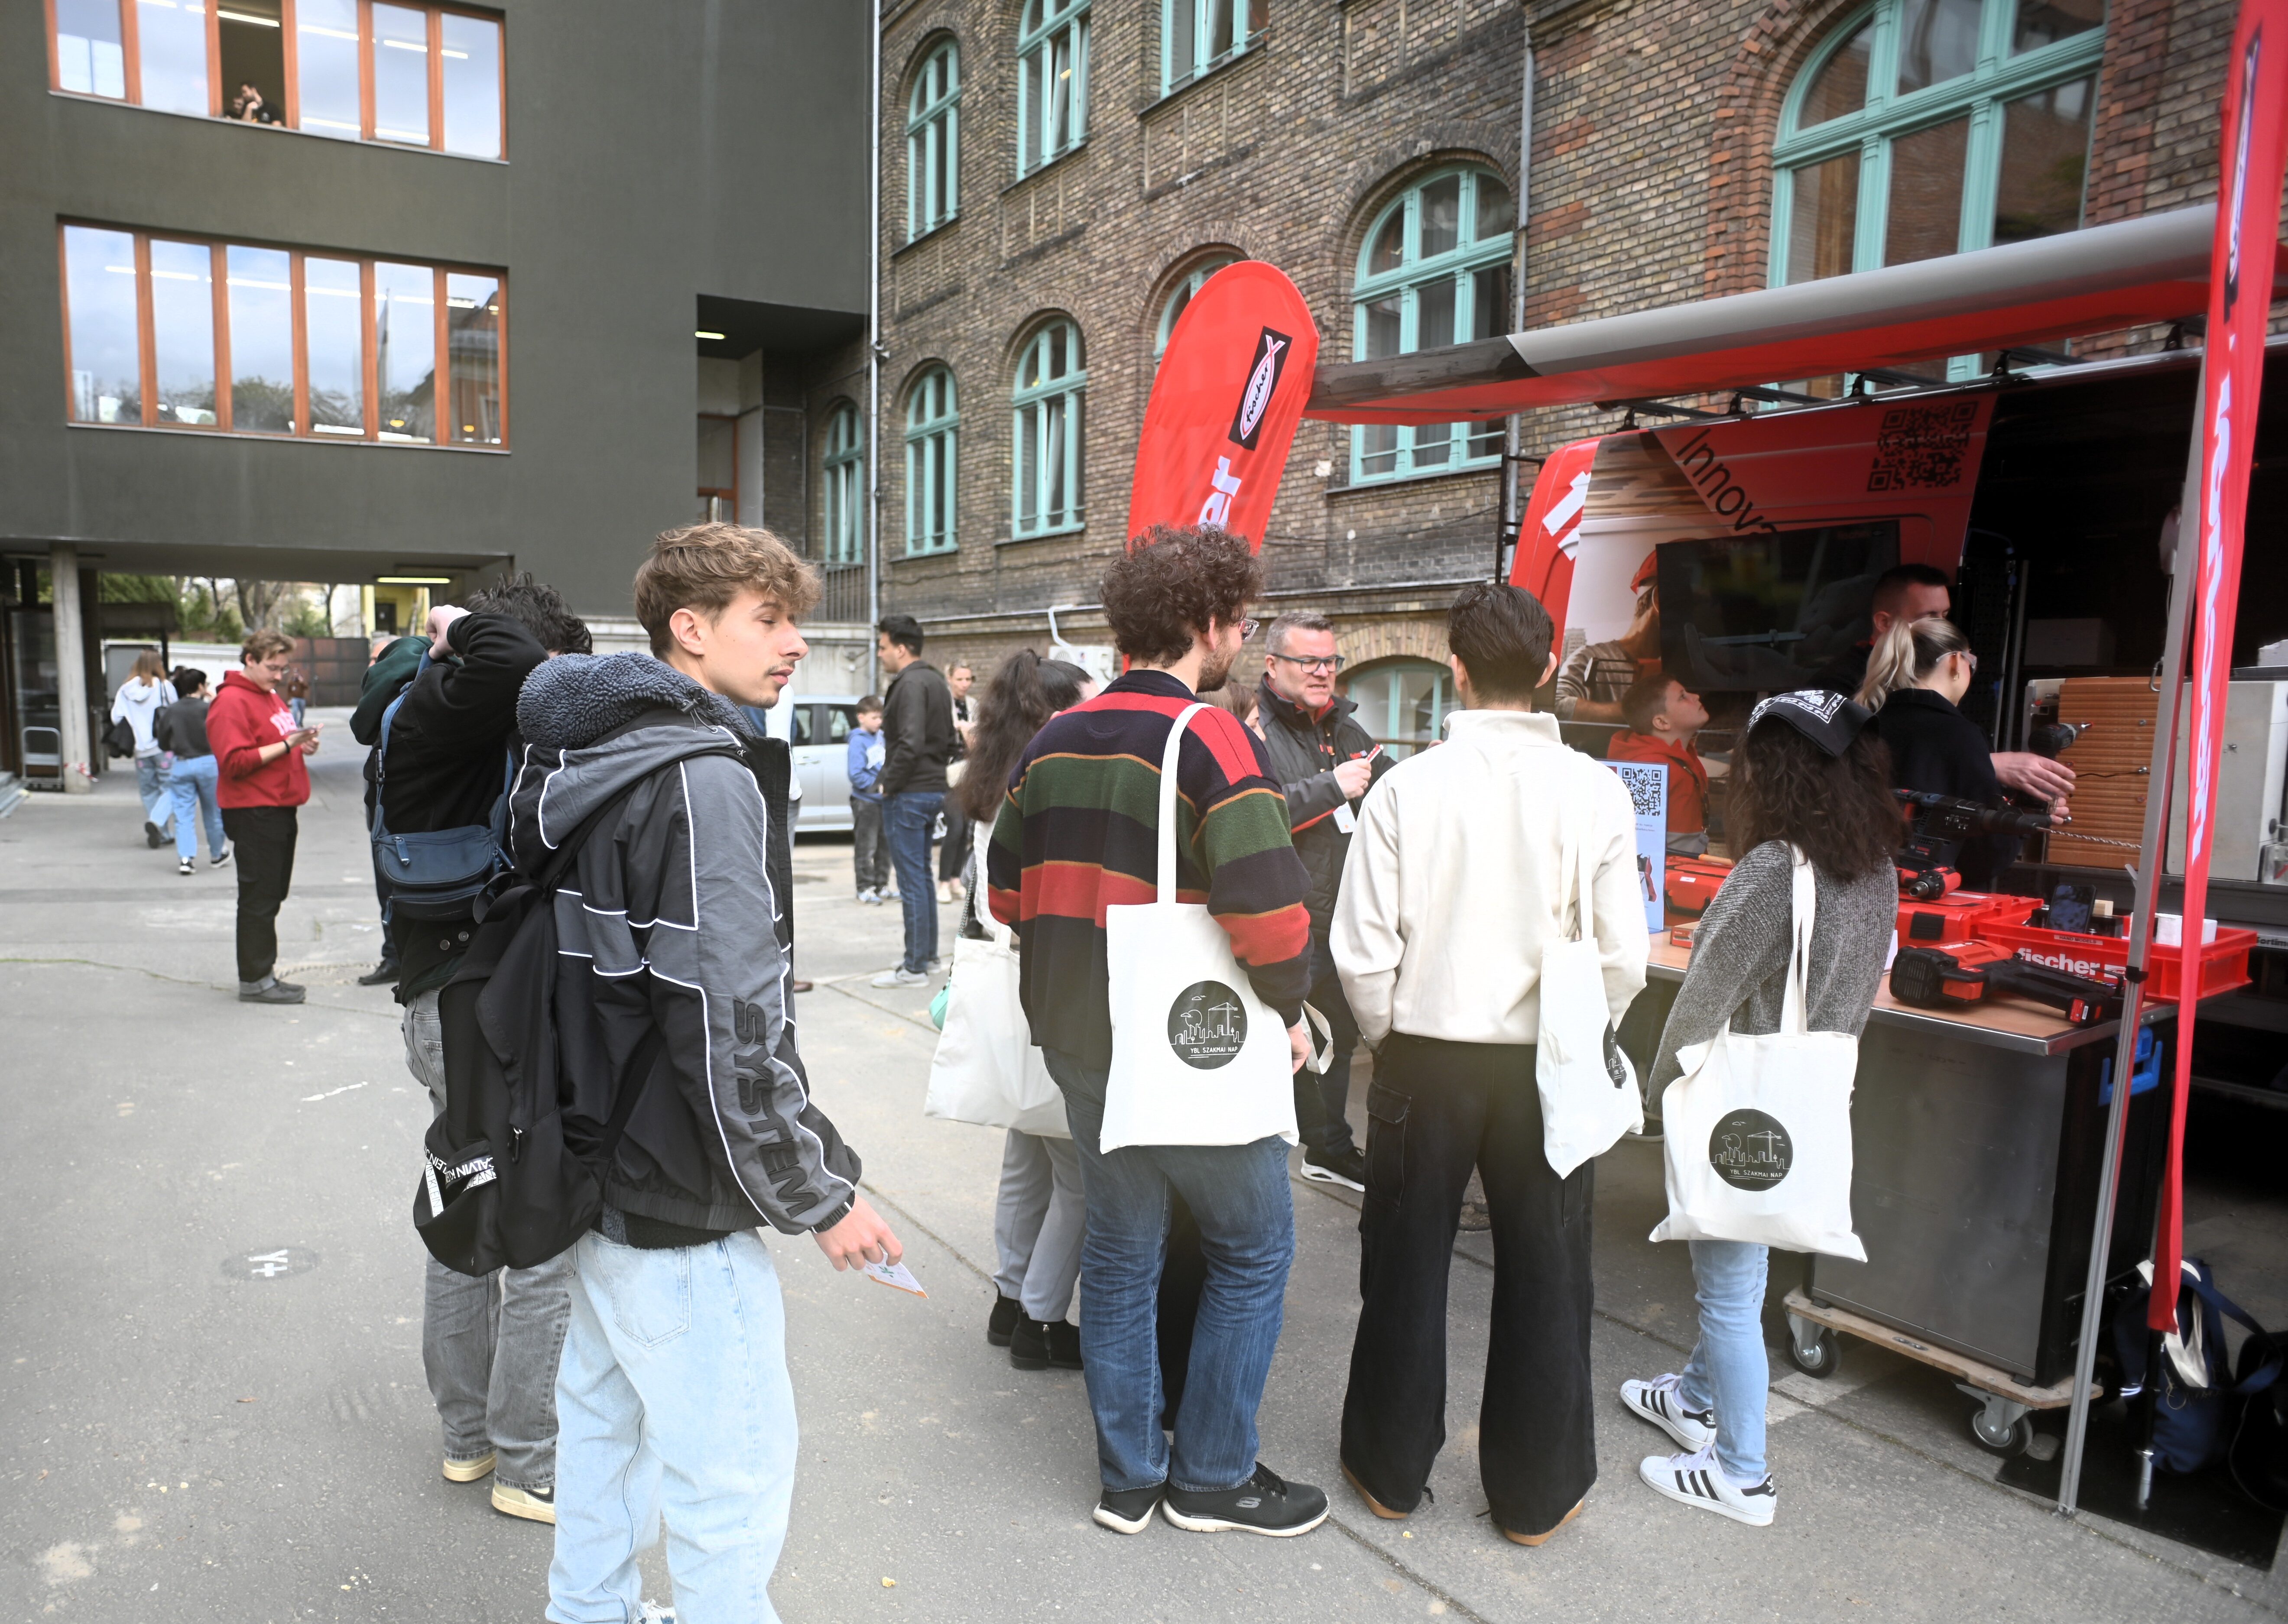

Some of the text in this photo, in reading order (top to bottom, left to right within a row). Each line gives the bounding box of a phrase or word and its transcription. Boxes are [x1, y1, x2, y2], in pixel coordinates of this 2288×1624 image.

[1246, 363, 1269, 424] fischer
[2257, 936, 2288, 947] ortim
[2017, 947, 2101, 976] fischer
[733, 998, 820, 1219] SYSTEM
[468, 1169, 496, 1187] JEAN
